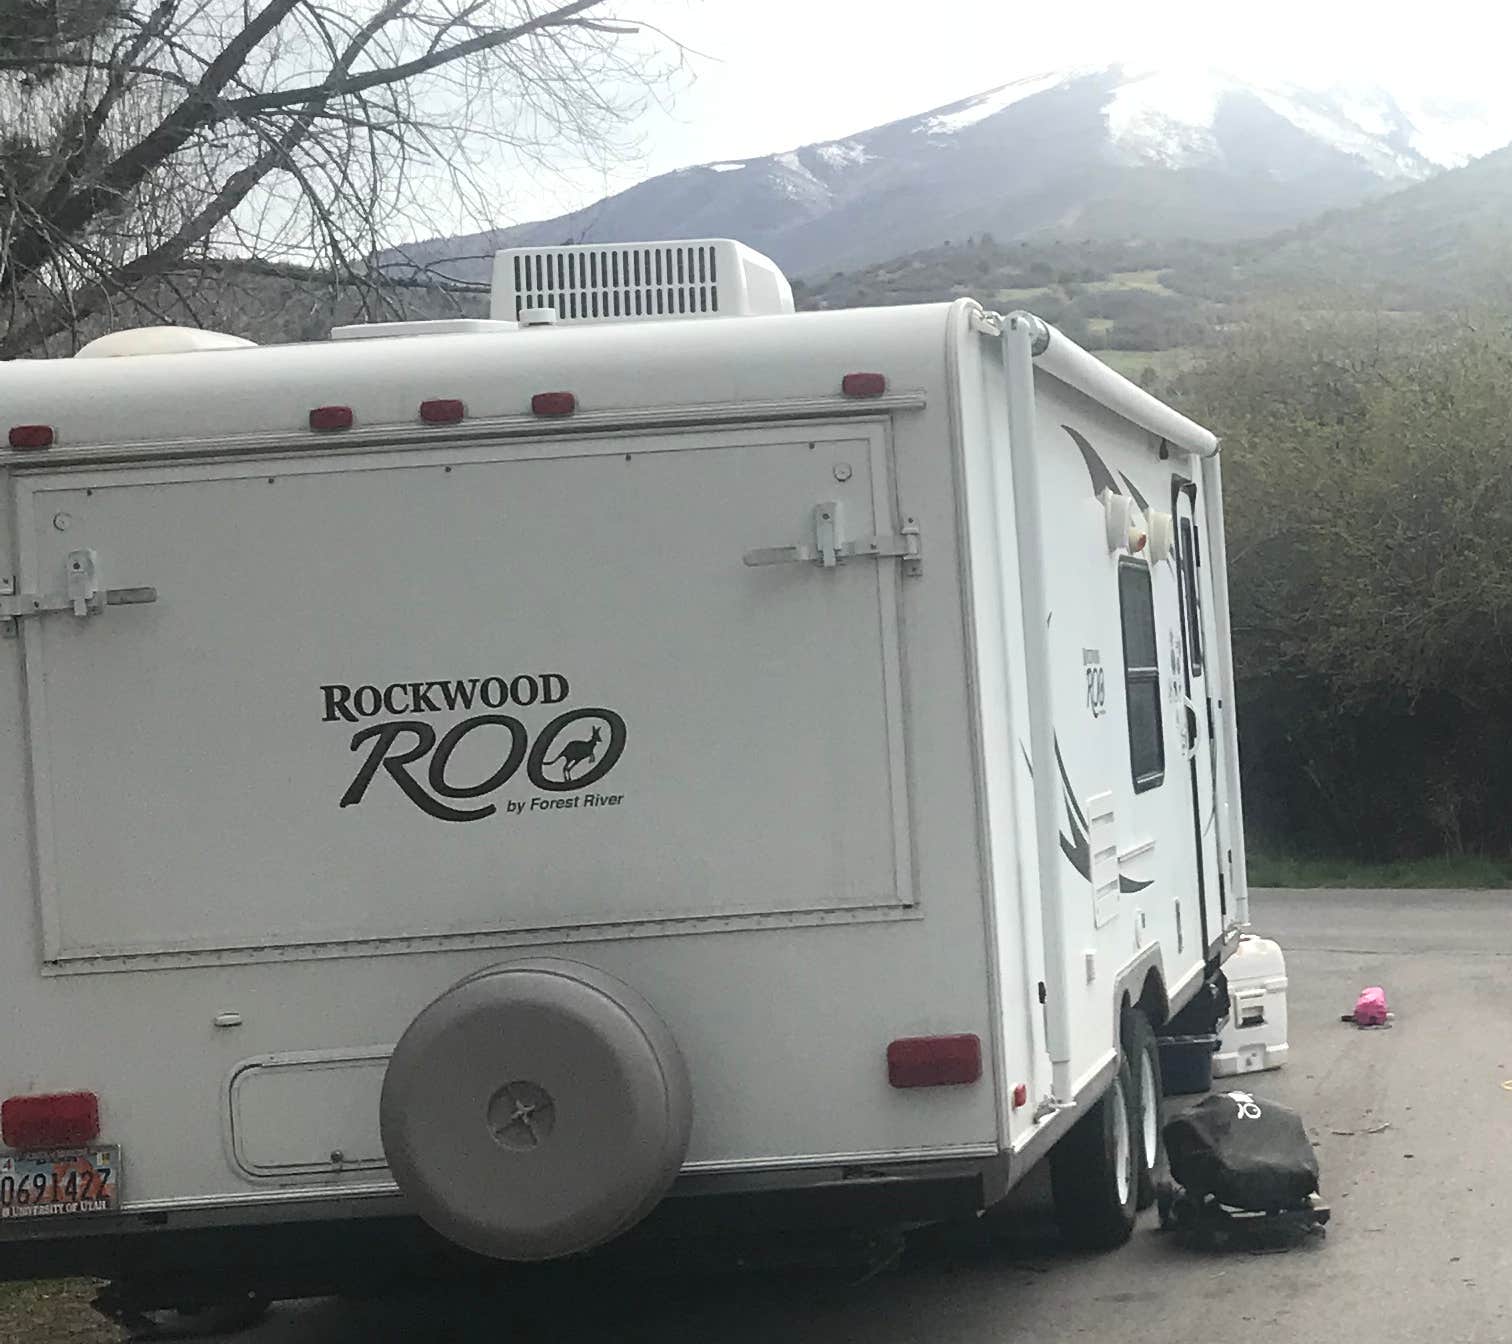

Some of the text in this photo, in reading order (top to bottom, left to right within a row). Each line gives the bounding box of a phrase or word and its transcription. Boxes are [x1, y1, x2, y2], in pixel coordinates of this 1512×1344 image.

[319, 673, 570, 723] ROCKWOOD
[339, 708, 627, 822] ROO
[506, 792, 625, 814] by Forest River
[80, 1200, 107, 1212] UTAH
